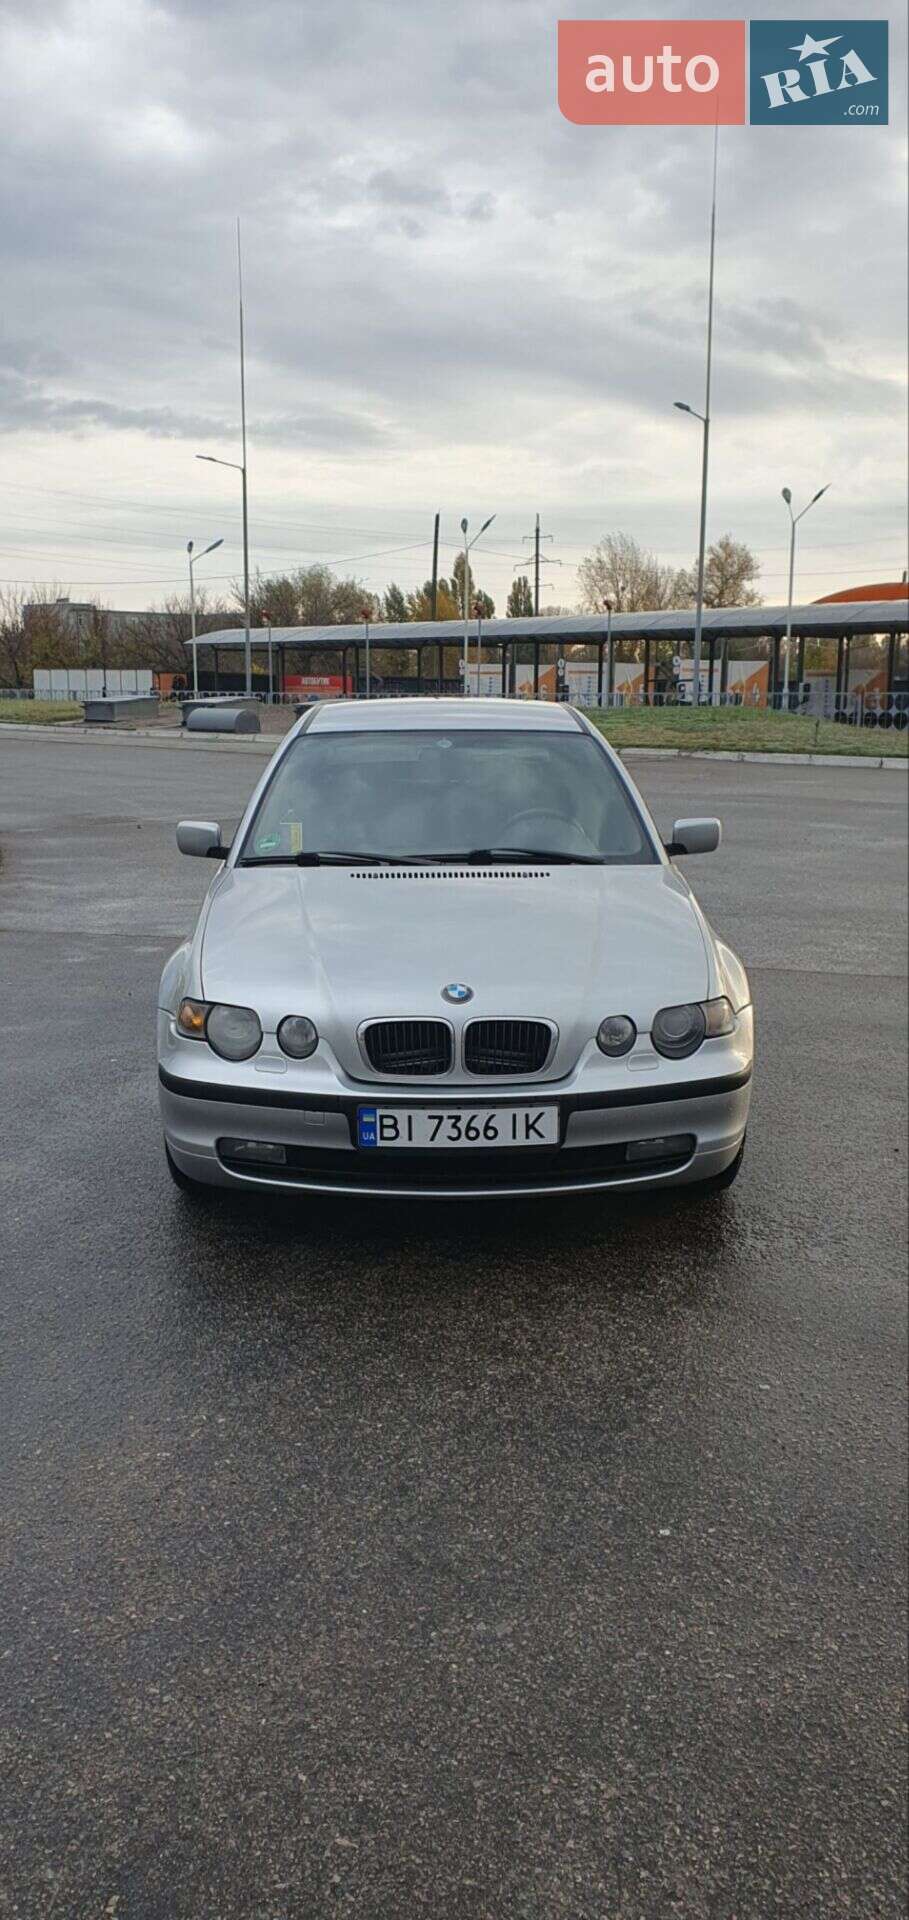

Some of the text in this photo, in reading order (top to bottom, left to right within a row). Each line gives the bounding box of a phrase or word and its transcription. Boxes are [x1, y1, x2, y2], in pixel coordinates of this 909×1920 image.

[379, 1111, 546, 1142] BI 7366 IK
[362, 1133, 375, 1141] UA
